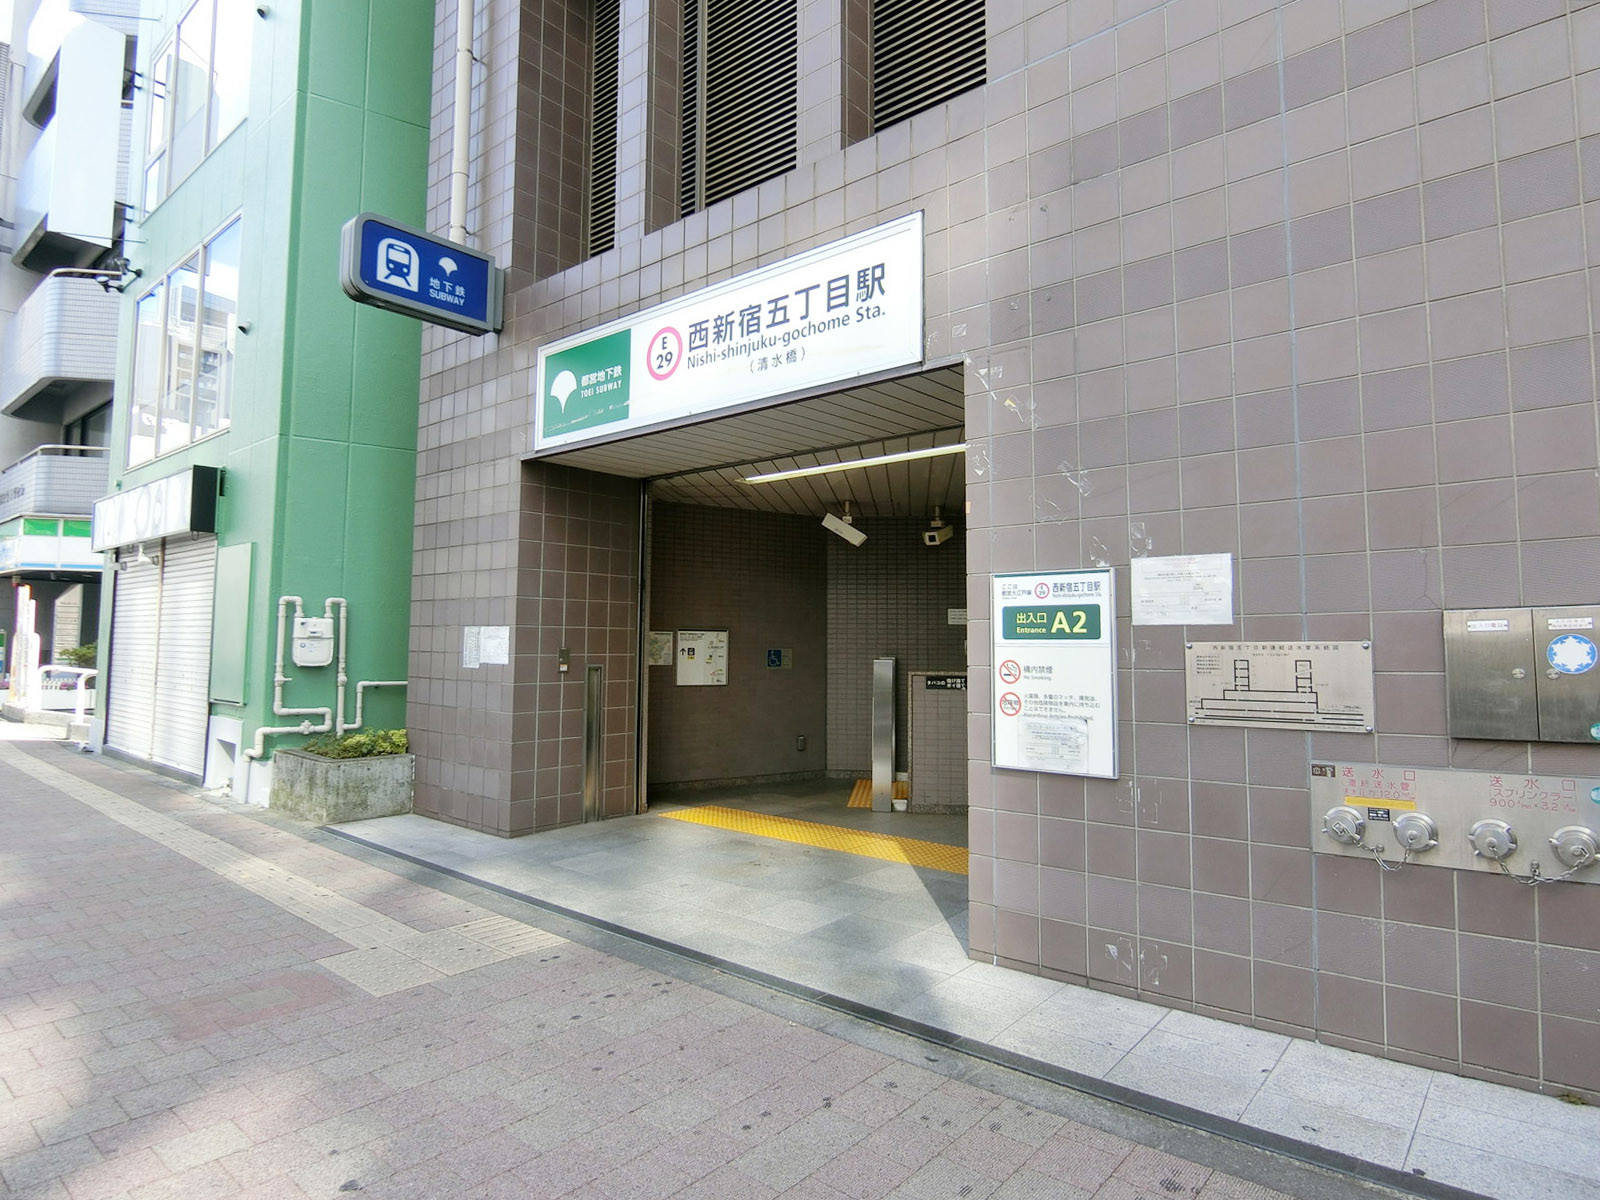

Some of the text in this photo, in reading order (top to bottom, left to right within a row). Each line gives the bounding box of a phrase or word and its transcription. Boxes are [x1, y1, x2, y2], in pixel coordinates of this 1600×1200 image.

[429, 276, 465, 297] 地下鉄
[429, 289, 465, 306] SUBWAY
[688, 263, 886, 353] 西新宿五丁目駅
[661, 336, 668, 350] E
[687, 303, 886, 370] Nishi-shinjuku-gochome Sta.
[656, 351, 673, 370] 29
[581, 365, 623, 387] 都営地下鉄
[580, 380, 622, 399] TOEI SUBWAY
[1052, 581, 1101, 593] 西新宿五丁目駅
[1016, 612, 1047, 624] 出入口
[1050, 611, 1088, 633] A2
[1016, 626, 1047, 634] Entrance
[1342, 767, 1416, 781] 送水口
[1489, 775, 1576, 791] 送水口
